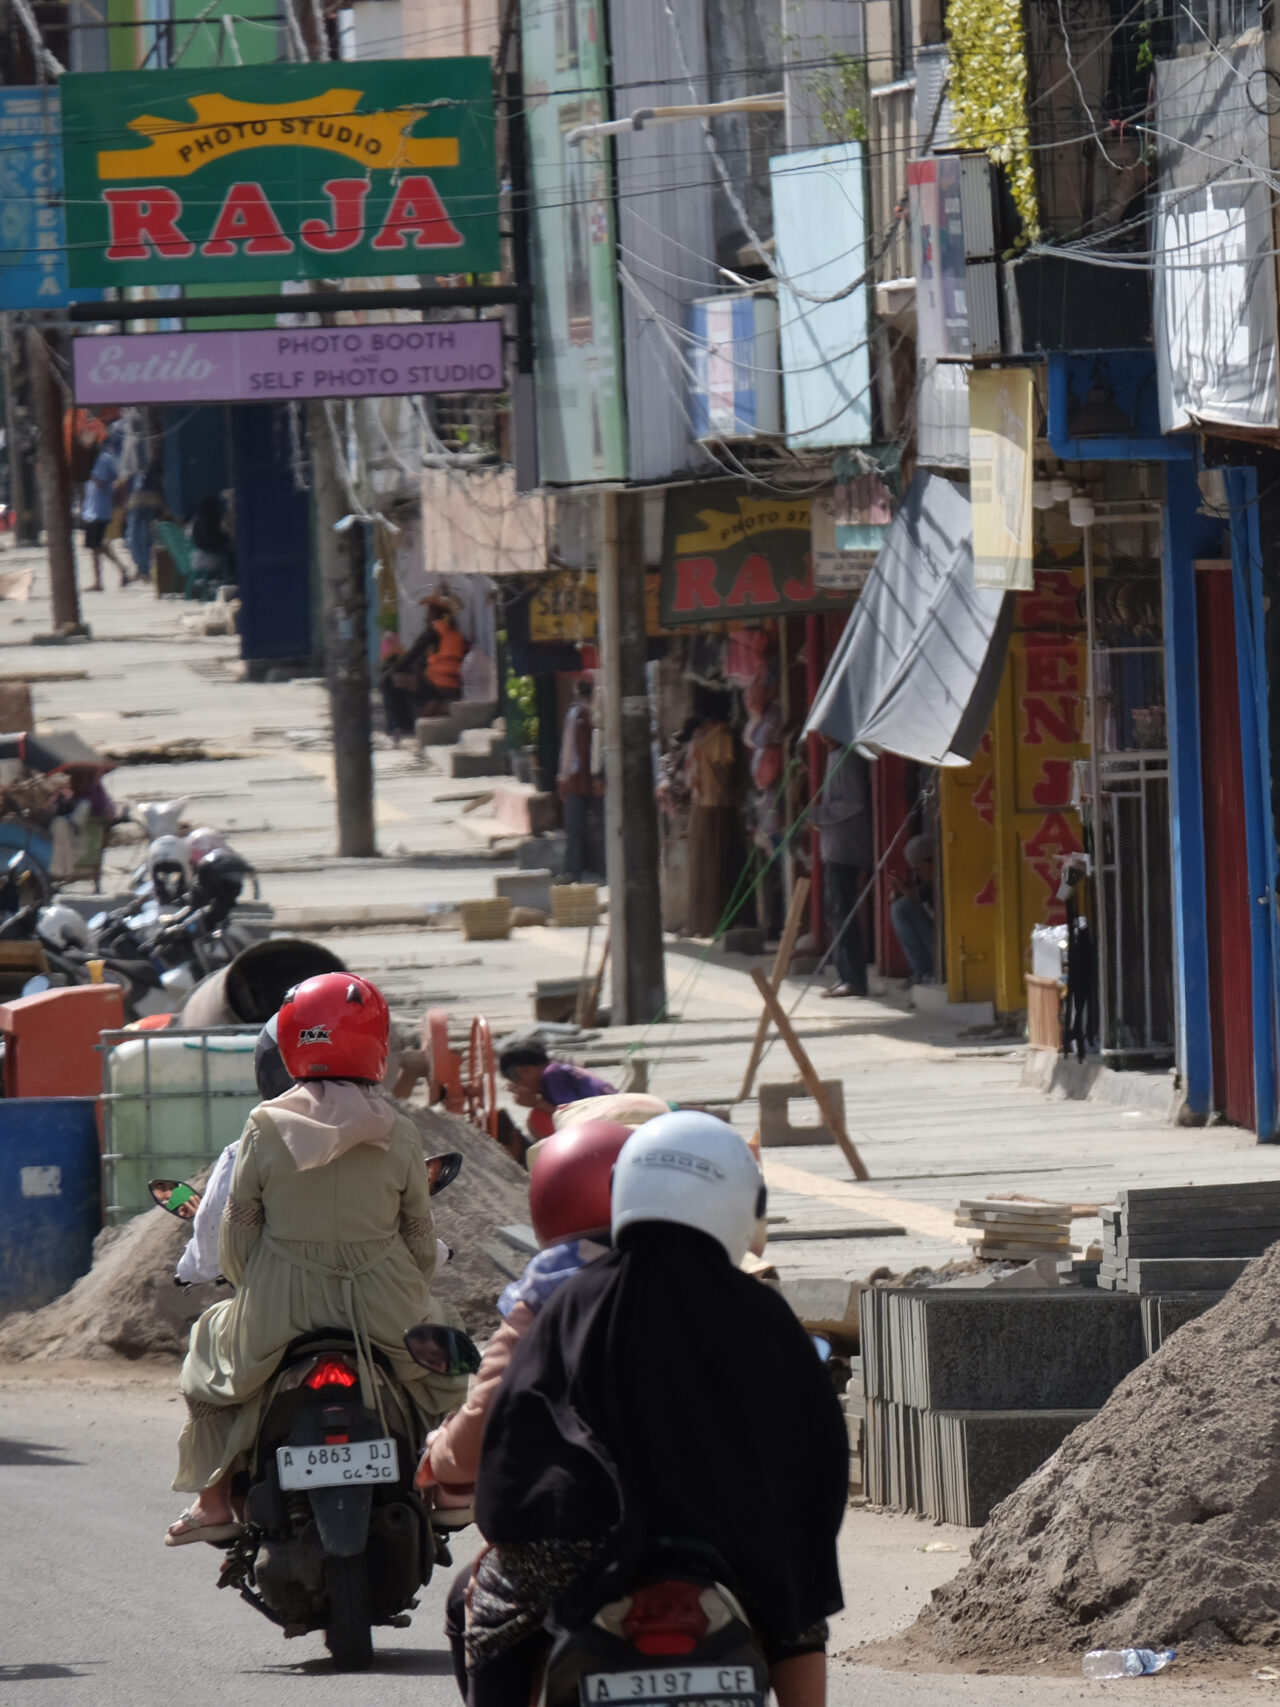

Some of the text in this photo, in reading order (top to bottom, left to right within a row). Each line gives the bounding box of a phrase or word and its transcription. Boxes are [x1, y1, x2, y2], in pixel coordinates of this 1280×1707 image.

[178, 118, 382, 163] PHOTO STUDIO
[103, 175, 464, 260] RAJA
[278, 331, 455, 355] PHOTO BOOTH
[89, 343, 221, 384] Estilo
[250, 364, 495, 390] SELF PHOTO STUDIO
[672, 553, 855, 611] RAJ
[284, 1443, 391, 1467] A 6863 DJ
[596, 1669, 747, 1699] A 3197 CF
